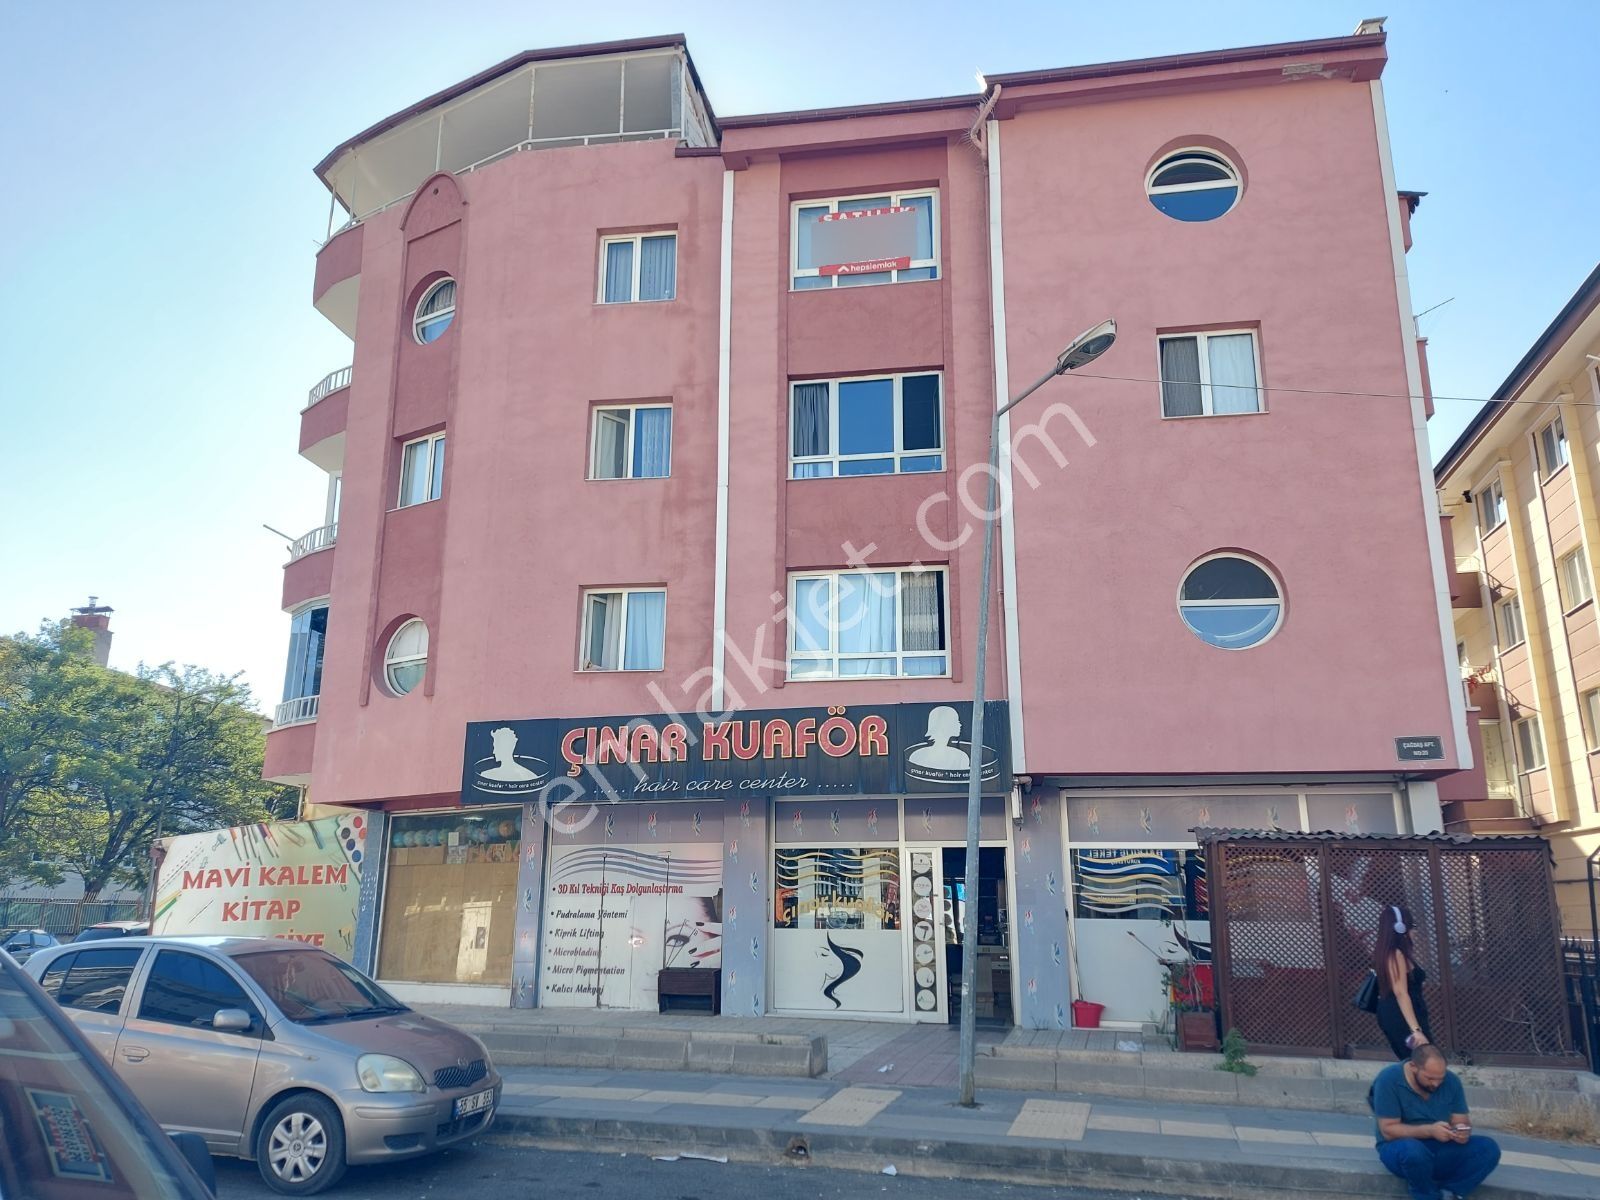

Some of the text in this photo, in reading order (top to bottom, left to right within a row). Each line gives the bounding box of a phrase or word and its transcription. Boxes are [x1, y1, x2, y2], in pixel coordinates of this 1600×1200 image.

[850, 260, 897, 272] hepsiemlak
[561, 705, 889, 777] ÇINAR KUAFÖR
[634, 771, 809, 792] hair care center
[182, 861, 349, 890] MAVİ KALEM
[221, 896, 301, 922] KİTAP
[555, 909, 596, 919] Pudralama
[554, 928, 605, 940] Kiprik Lifting
[552, 965, 625, 976] Micro Pigmentation
